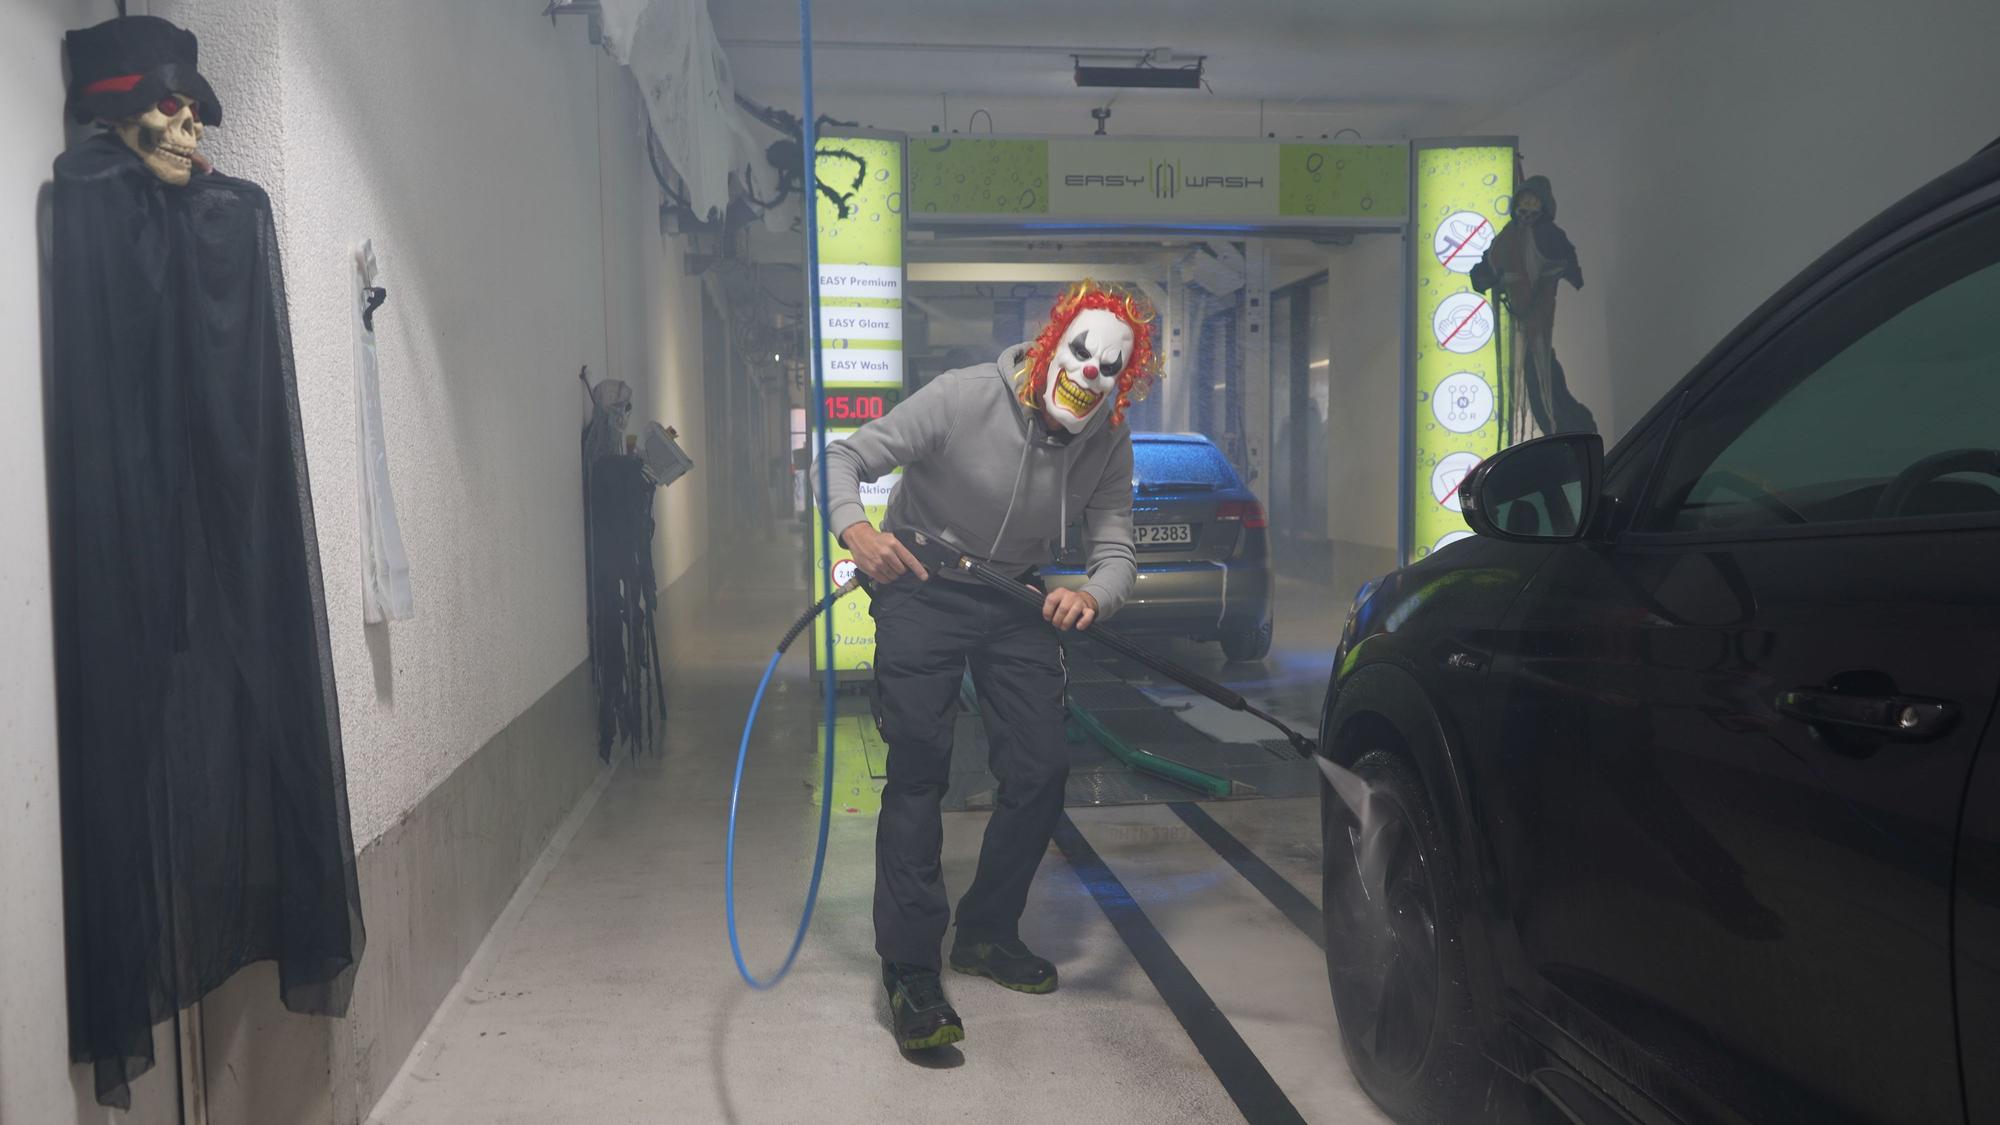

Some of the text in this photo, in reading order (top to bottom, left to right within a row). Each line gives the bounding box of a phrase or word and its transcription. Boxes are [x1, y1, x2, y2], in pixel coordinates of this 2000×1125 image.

[1064, 174, 1264, 188] EASY WASH
[820, 275, 897, 288] EASY Premium
[828, 318, 890, 329] EASY Glanz
[830, 360, 889, 371] EASY Wash
[825, 396, 883, 419] 15.00
[1151, 526, 1188, 541] 2383
[844, 635, 875, 645] Was
